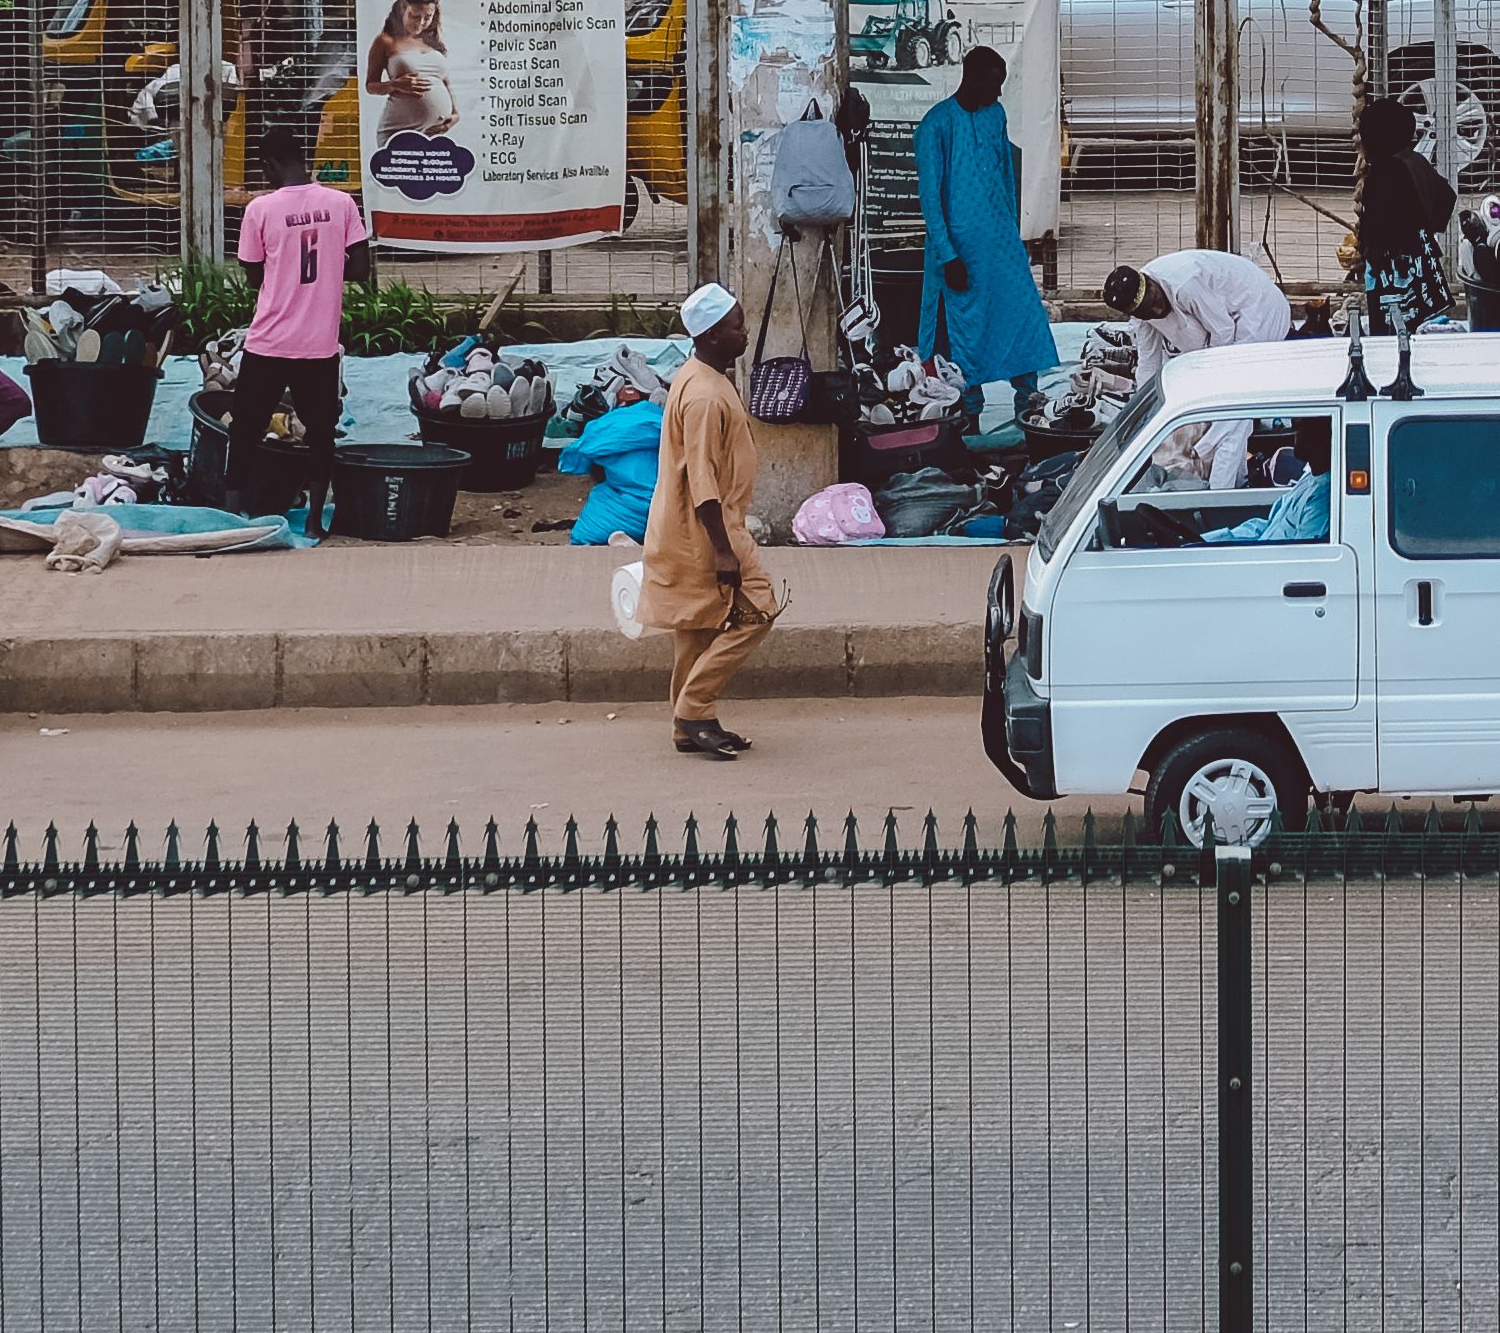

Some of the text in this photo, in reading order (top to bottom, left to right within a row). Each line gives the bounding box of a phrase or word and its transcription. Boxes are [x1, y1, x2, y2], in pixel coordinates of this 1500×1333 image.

[488, 0, 584, 14] Abdominal Scan
[489, 17, 616, 34] Abdominopelvic Scan
[490, 39, 557, 52] Pelvic Scan
[489, 58, 560, 71] Breast Scan
[489, 76, 564, 89] Scrotal Scan
[489, 94, 567, 111] Thyroid Scan
[489, 112, 588, 127] Soft Tissue Scan
[490, 133, 525, 149] X-Ray
[490, 151, 517, 165] ECG
[483, 170, 525, 183] Laboratory
[526, 168, 559, 181] Services
[562, 166, 578, 179] Also
[300, 228, 318, 285] 6
